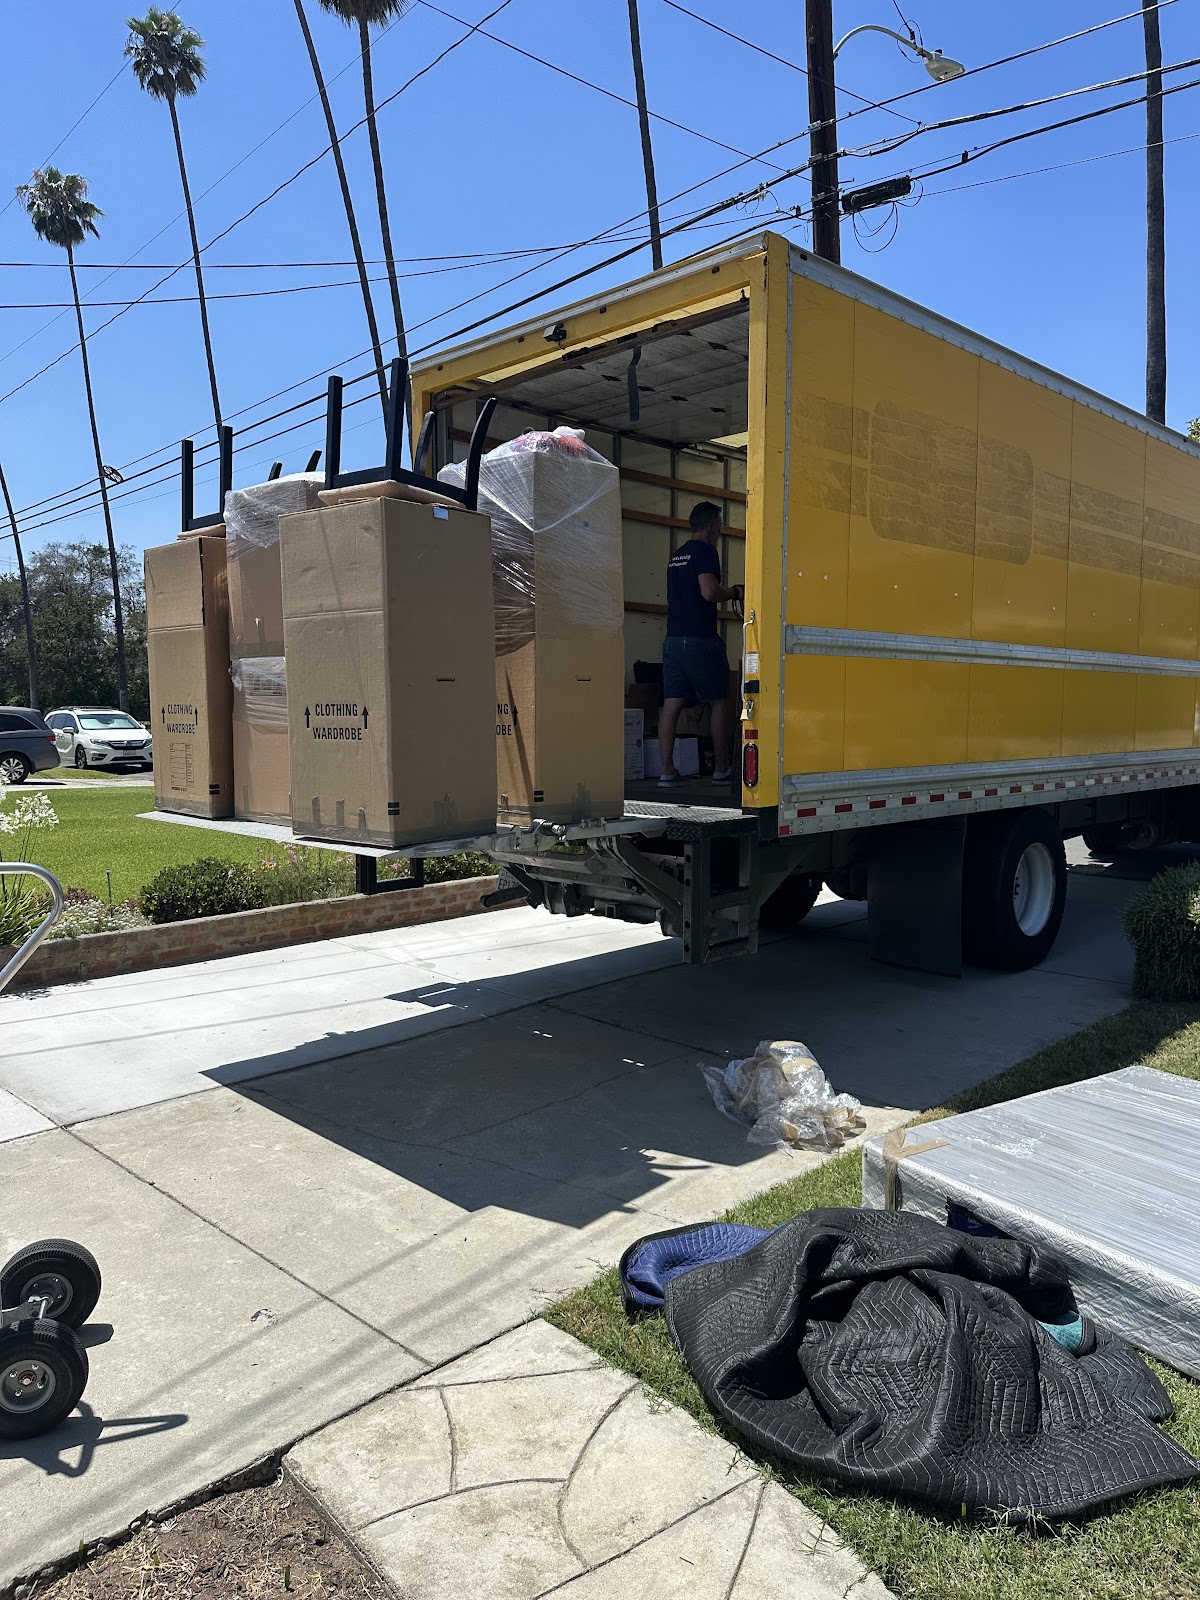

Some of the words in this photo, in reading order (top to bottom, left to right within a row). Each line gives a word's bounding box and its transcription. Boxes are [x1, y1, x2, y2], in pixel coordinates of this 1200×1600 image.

[167, 704, 193, 715] CLOTHING
[315, 703, 358, 717] CLOTHING
[166, 723, 196, 734] WARDROBE
[312, 727, 363, 740] WARDROBE
